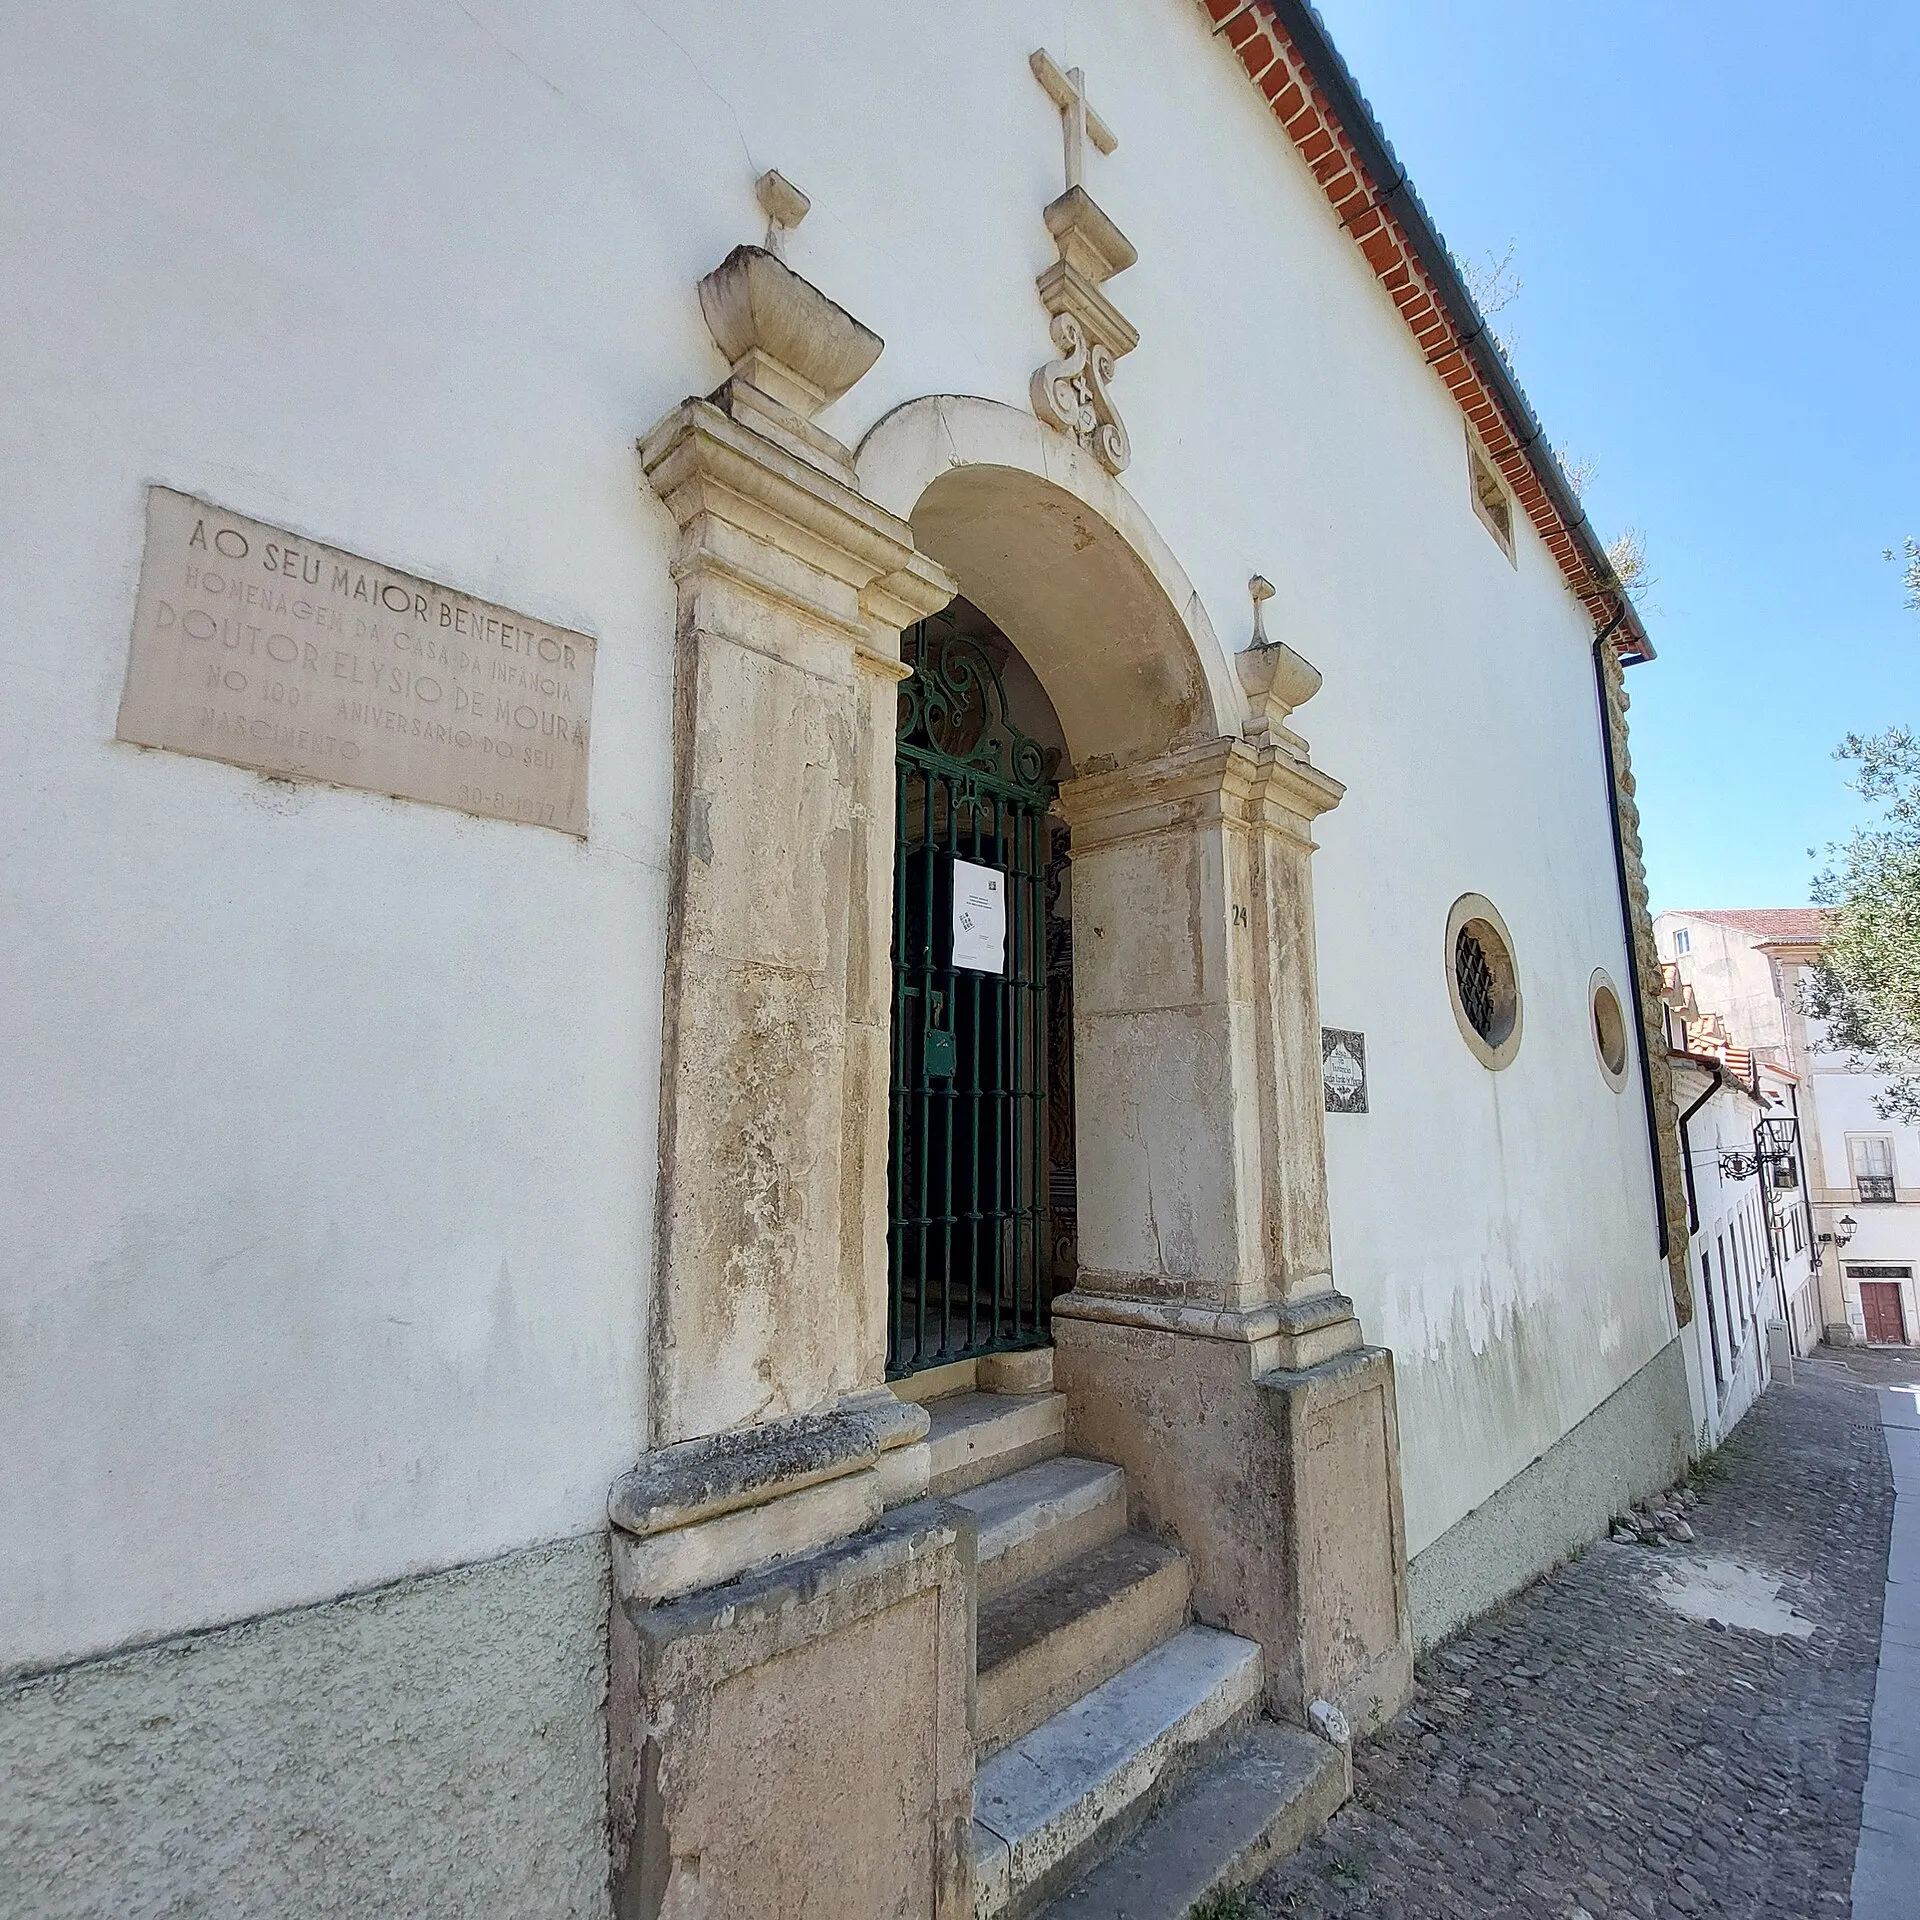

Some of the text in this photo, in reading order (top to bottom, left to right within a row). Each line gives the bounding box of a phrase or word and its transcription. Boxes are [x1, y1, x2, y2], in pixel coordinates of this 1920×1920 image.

[185, 565, 343, 634] HOMENAGEM
[356, 618, 380, 642] DA
[393, 632, 448, 664] CASA
[460, 651, 481, 674] DA
[189, 519, 576, 671] AO SEU MAIOR BENFEITOR
[156, 600, 584, 745] DOUTOR ELYSIO DE MOURA
[206, 664, 248, 692] NO
[483, 736, 513, 758] DO
[523, 747, 554, 770] SEU
[201, 706, 361, 760] NASCIMENTO
[1232, 904, 1247, 928] 24
